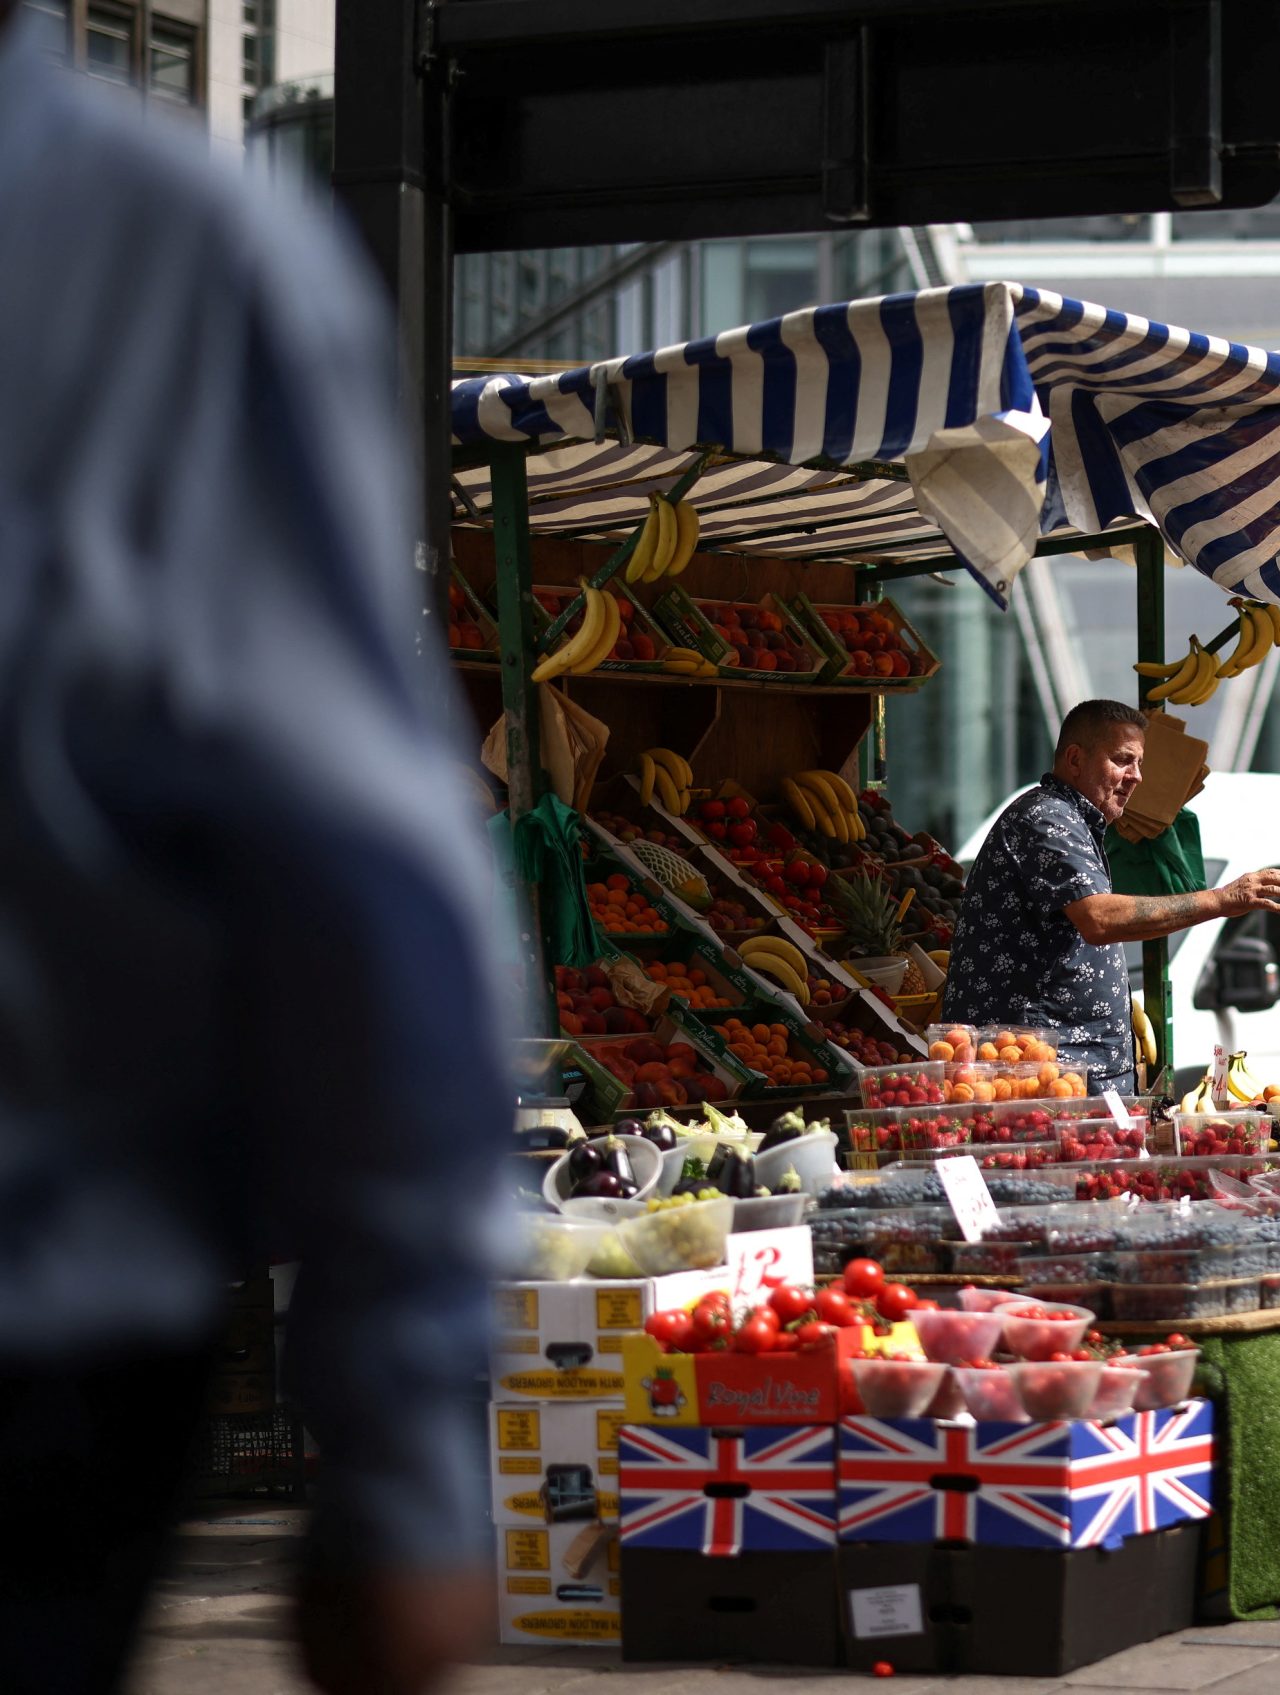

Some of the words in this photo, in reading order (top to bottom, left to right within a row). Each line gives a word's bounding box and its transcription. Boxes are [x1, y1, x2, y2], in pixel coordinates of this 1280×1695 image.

[600, 1377, 625, 1389] ORTH
[706, 1376, 772, 1416] Royal
[775, 1381, 820, 1406] Vine
